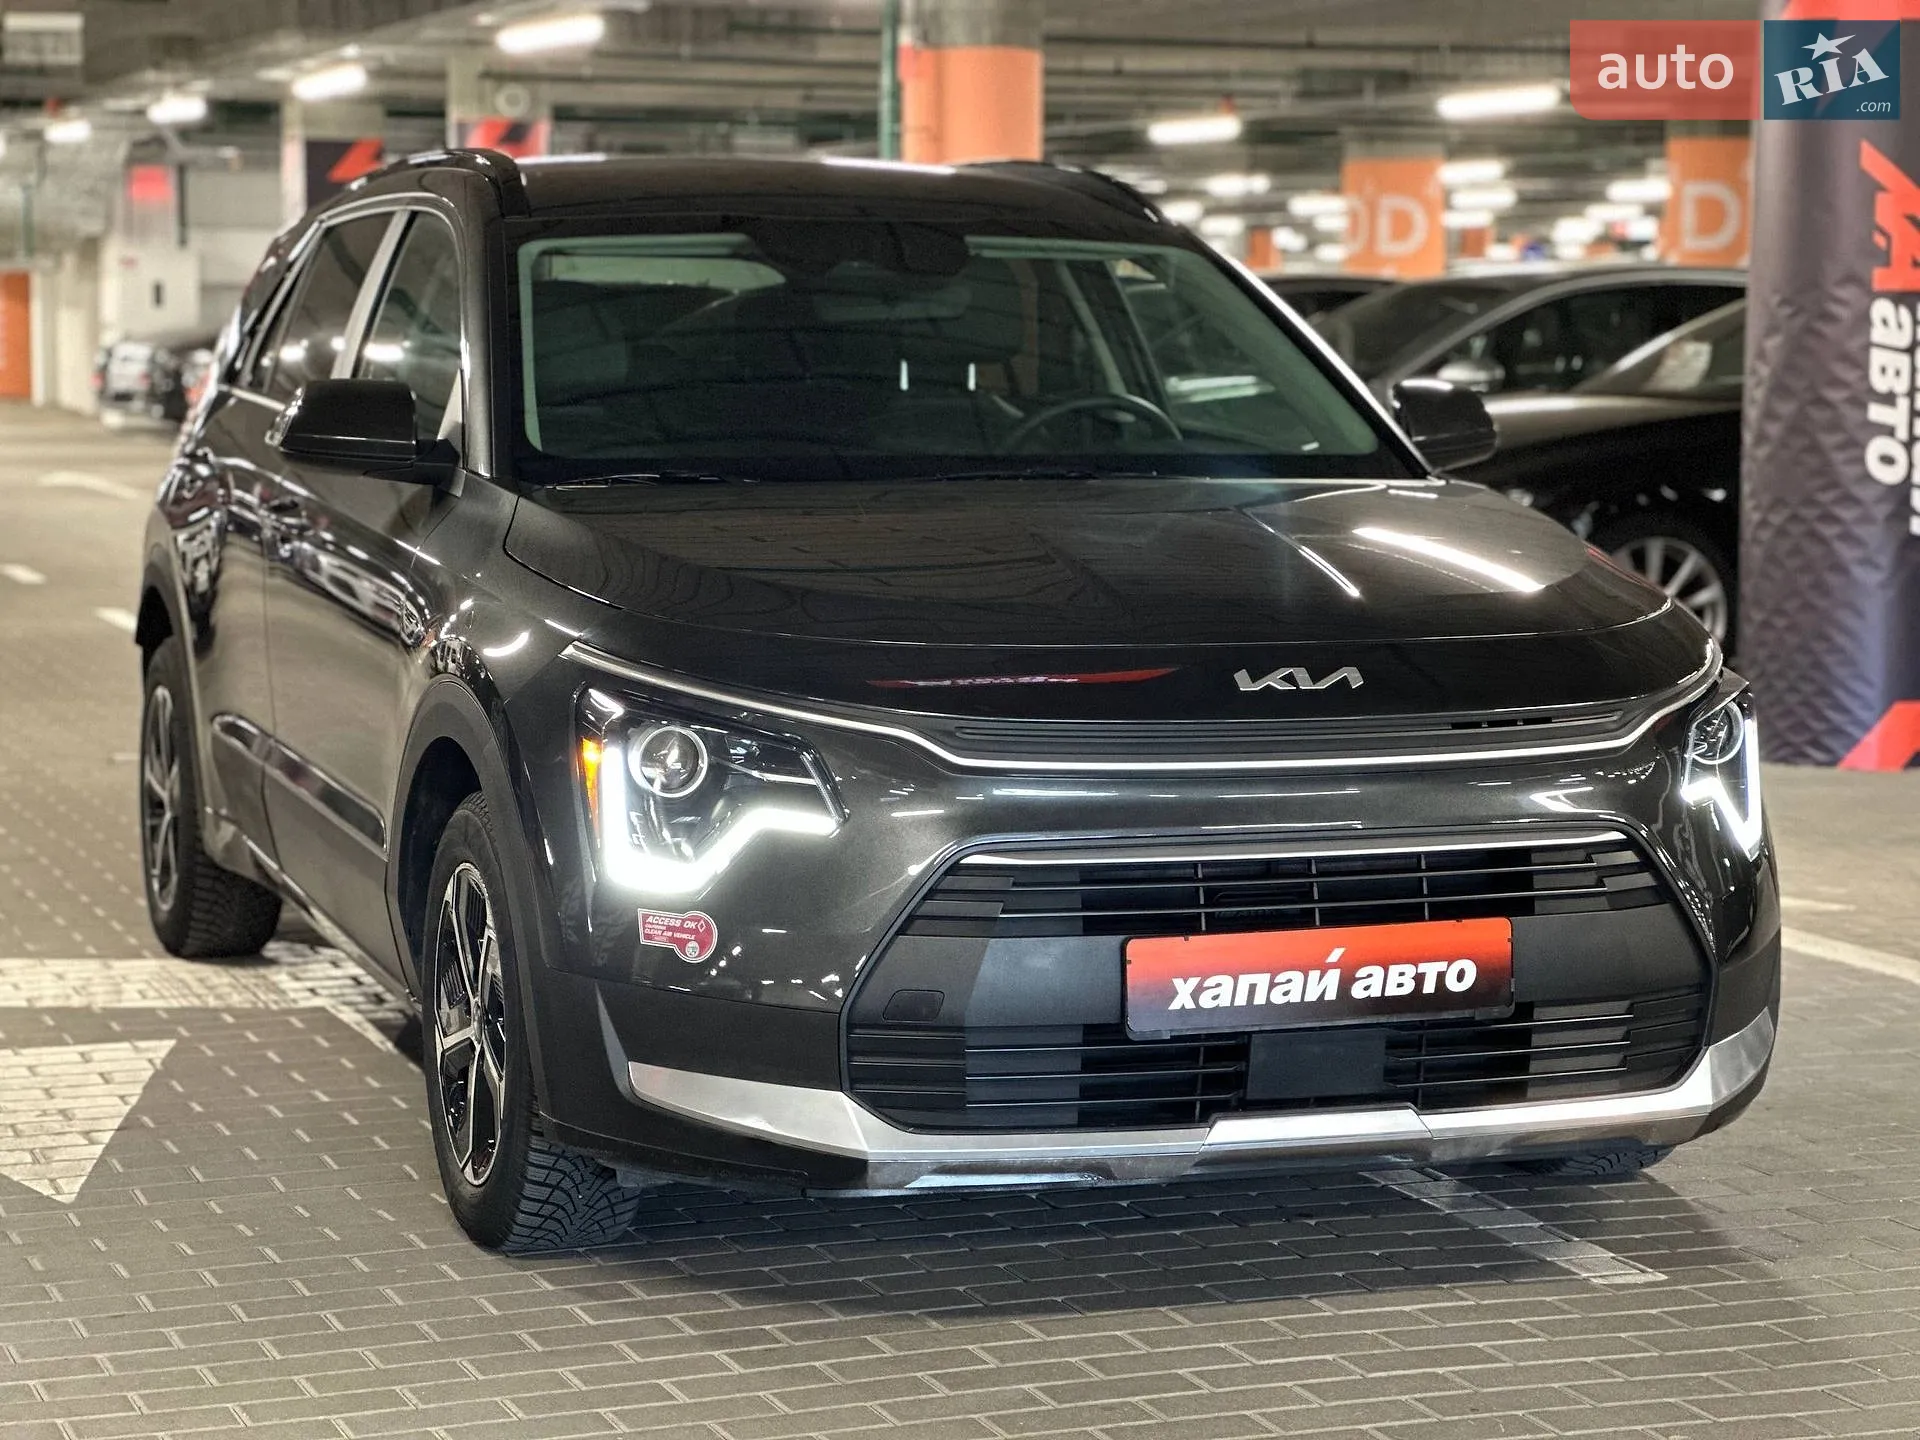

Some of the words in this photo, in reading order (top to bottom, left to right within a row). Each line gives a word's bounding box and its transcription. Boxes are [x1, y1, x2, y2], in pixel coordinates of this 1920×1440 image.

[1681, 182, 1741, 251] D
[1865, 297, 1913, 486] авто
[1233, 667, 1364, 691] KIA
[646, 915, 681, 927] ACCESS
[683, 920, 698, 929] OK
[1350, 958, 1477, 999] авто
